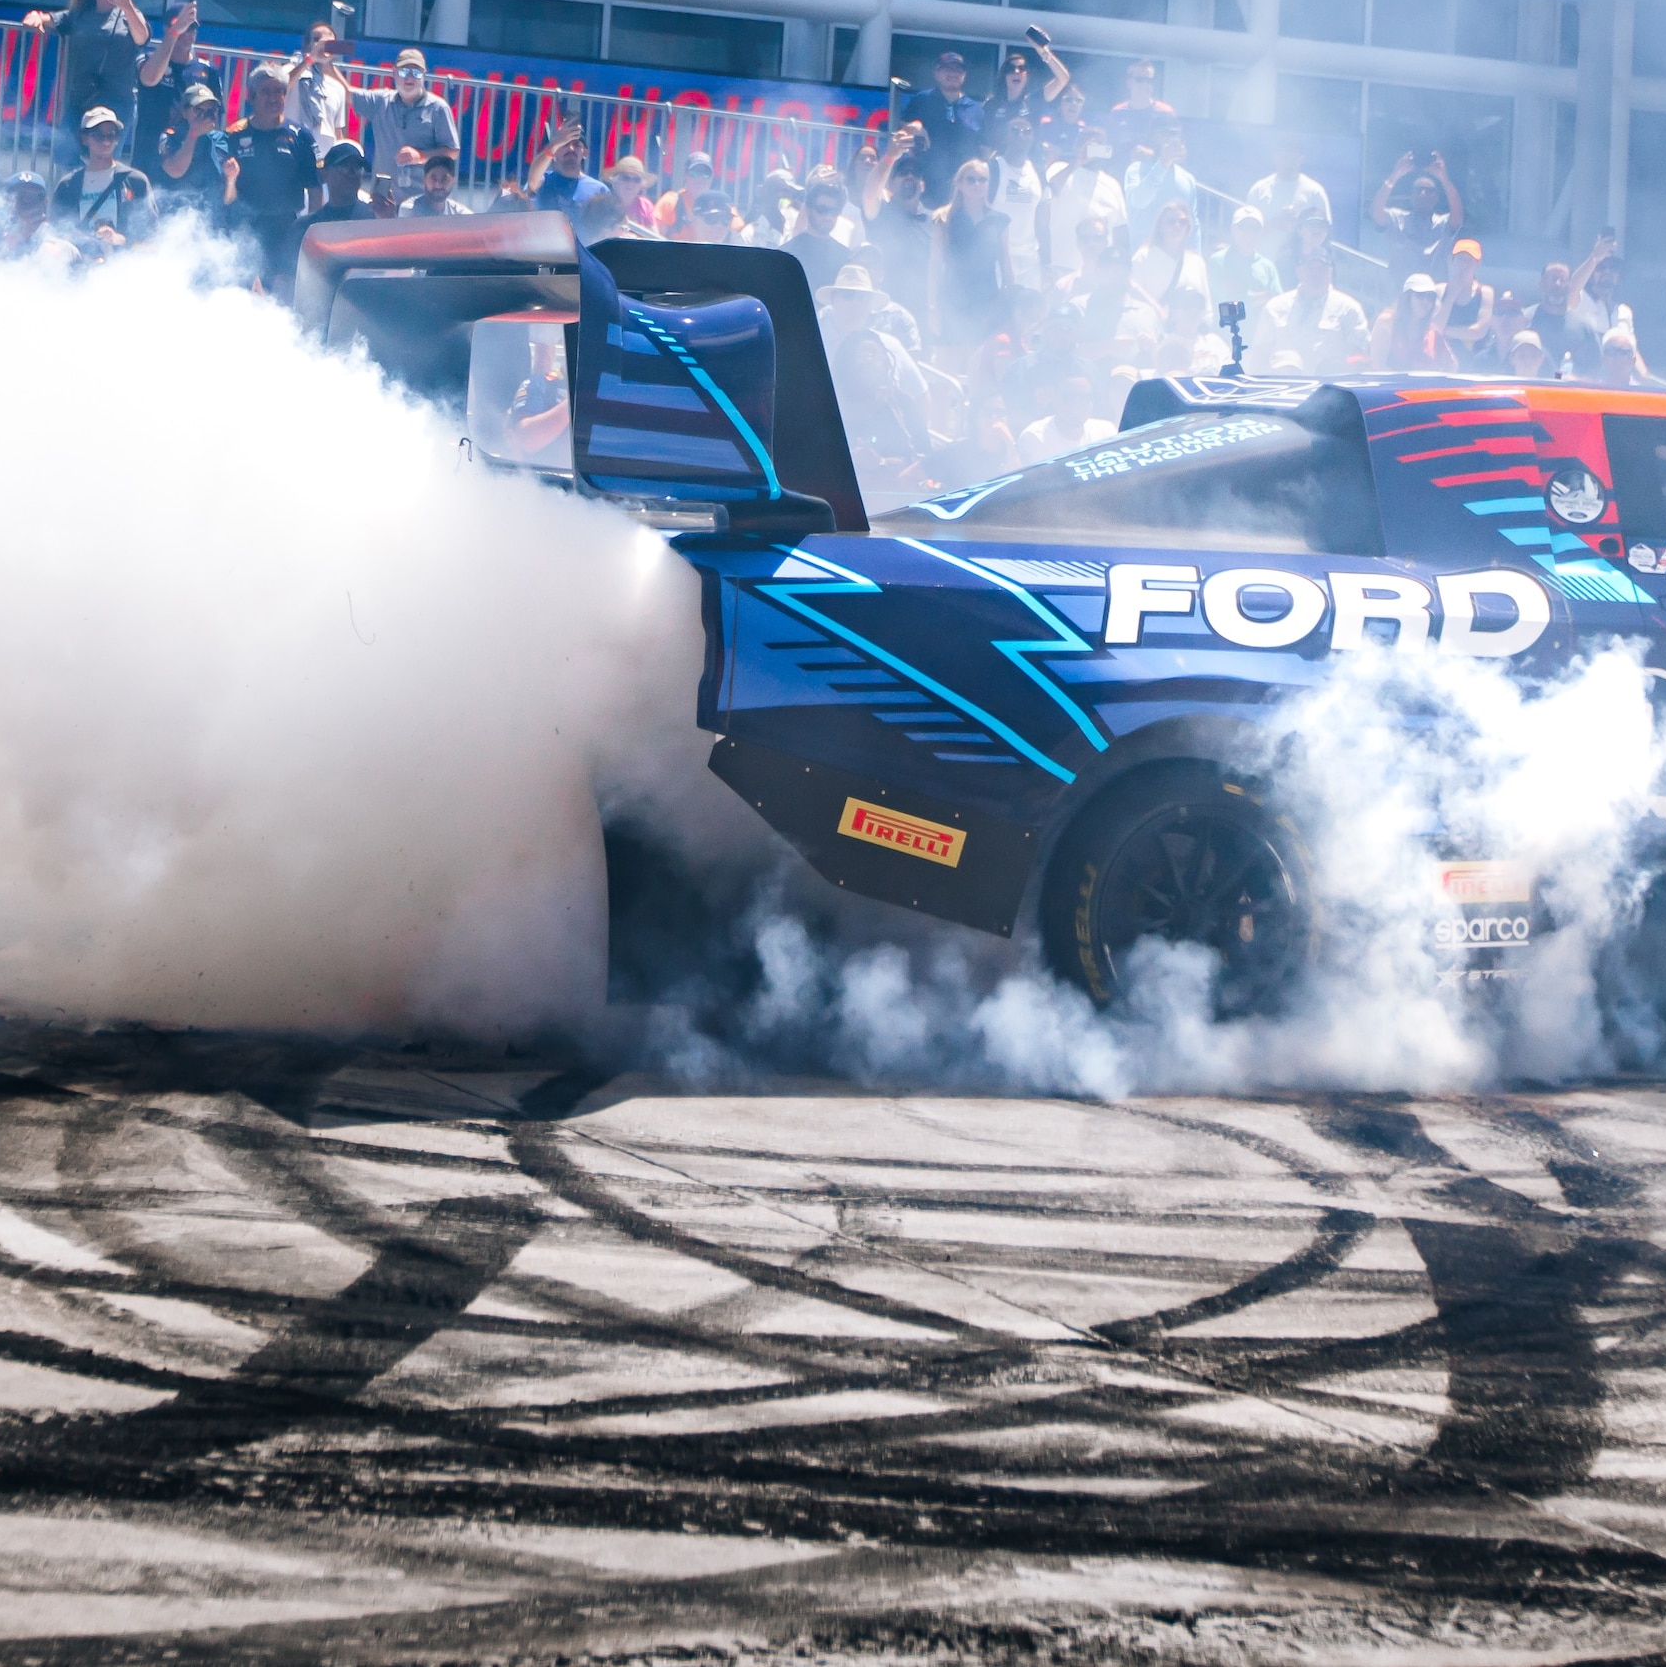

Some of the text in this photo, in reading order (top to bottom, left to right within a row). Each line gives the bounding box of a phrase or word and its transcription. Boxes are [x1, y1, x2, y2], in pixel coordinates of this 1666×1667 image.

[1064, 418, 1258, 468] CAUTION
[1073, 423, 1284, 482] THE MOUNTAIN
[1073, 433, 1224, 473] LIGHTNING
[1103, 562, 1551, 658] FORD
[851, 807, 955, 858] PIRELLI
[1434, 916, 1530, 949] sparco
